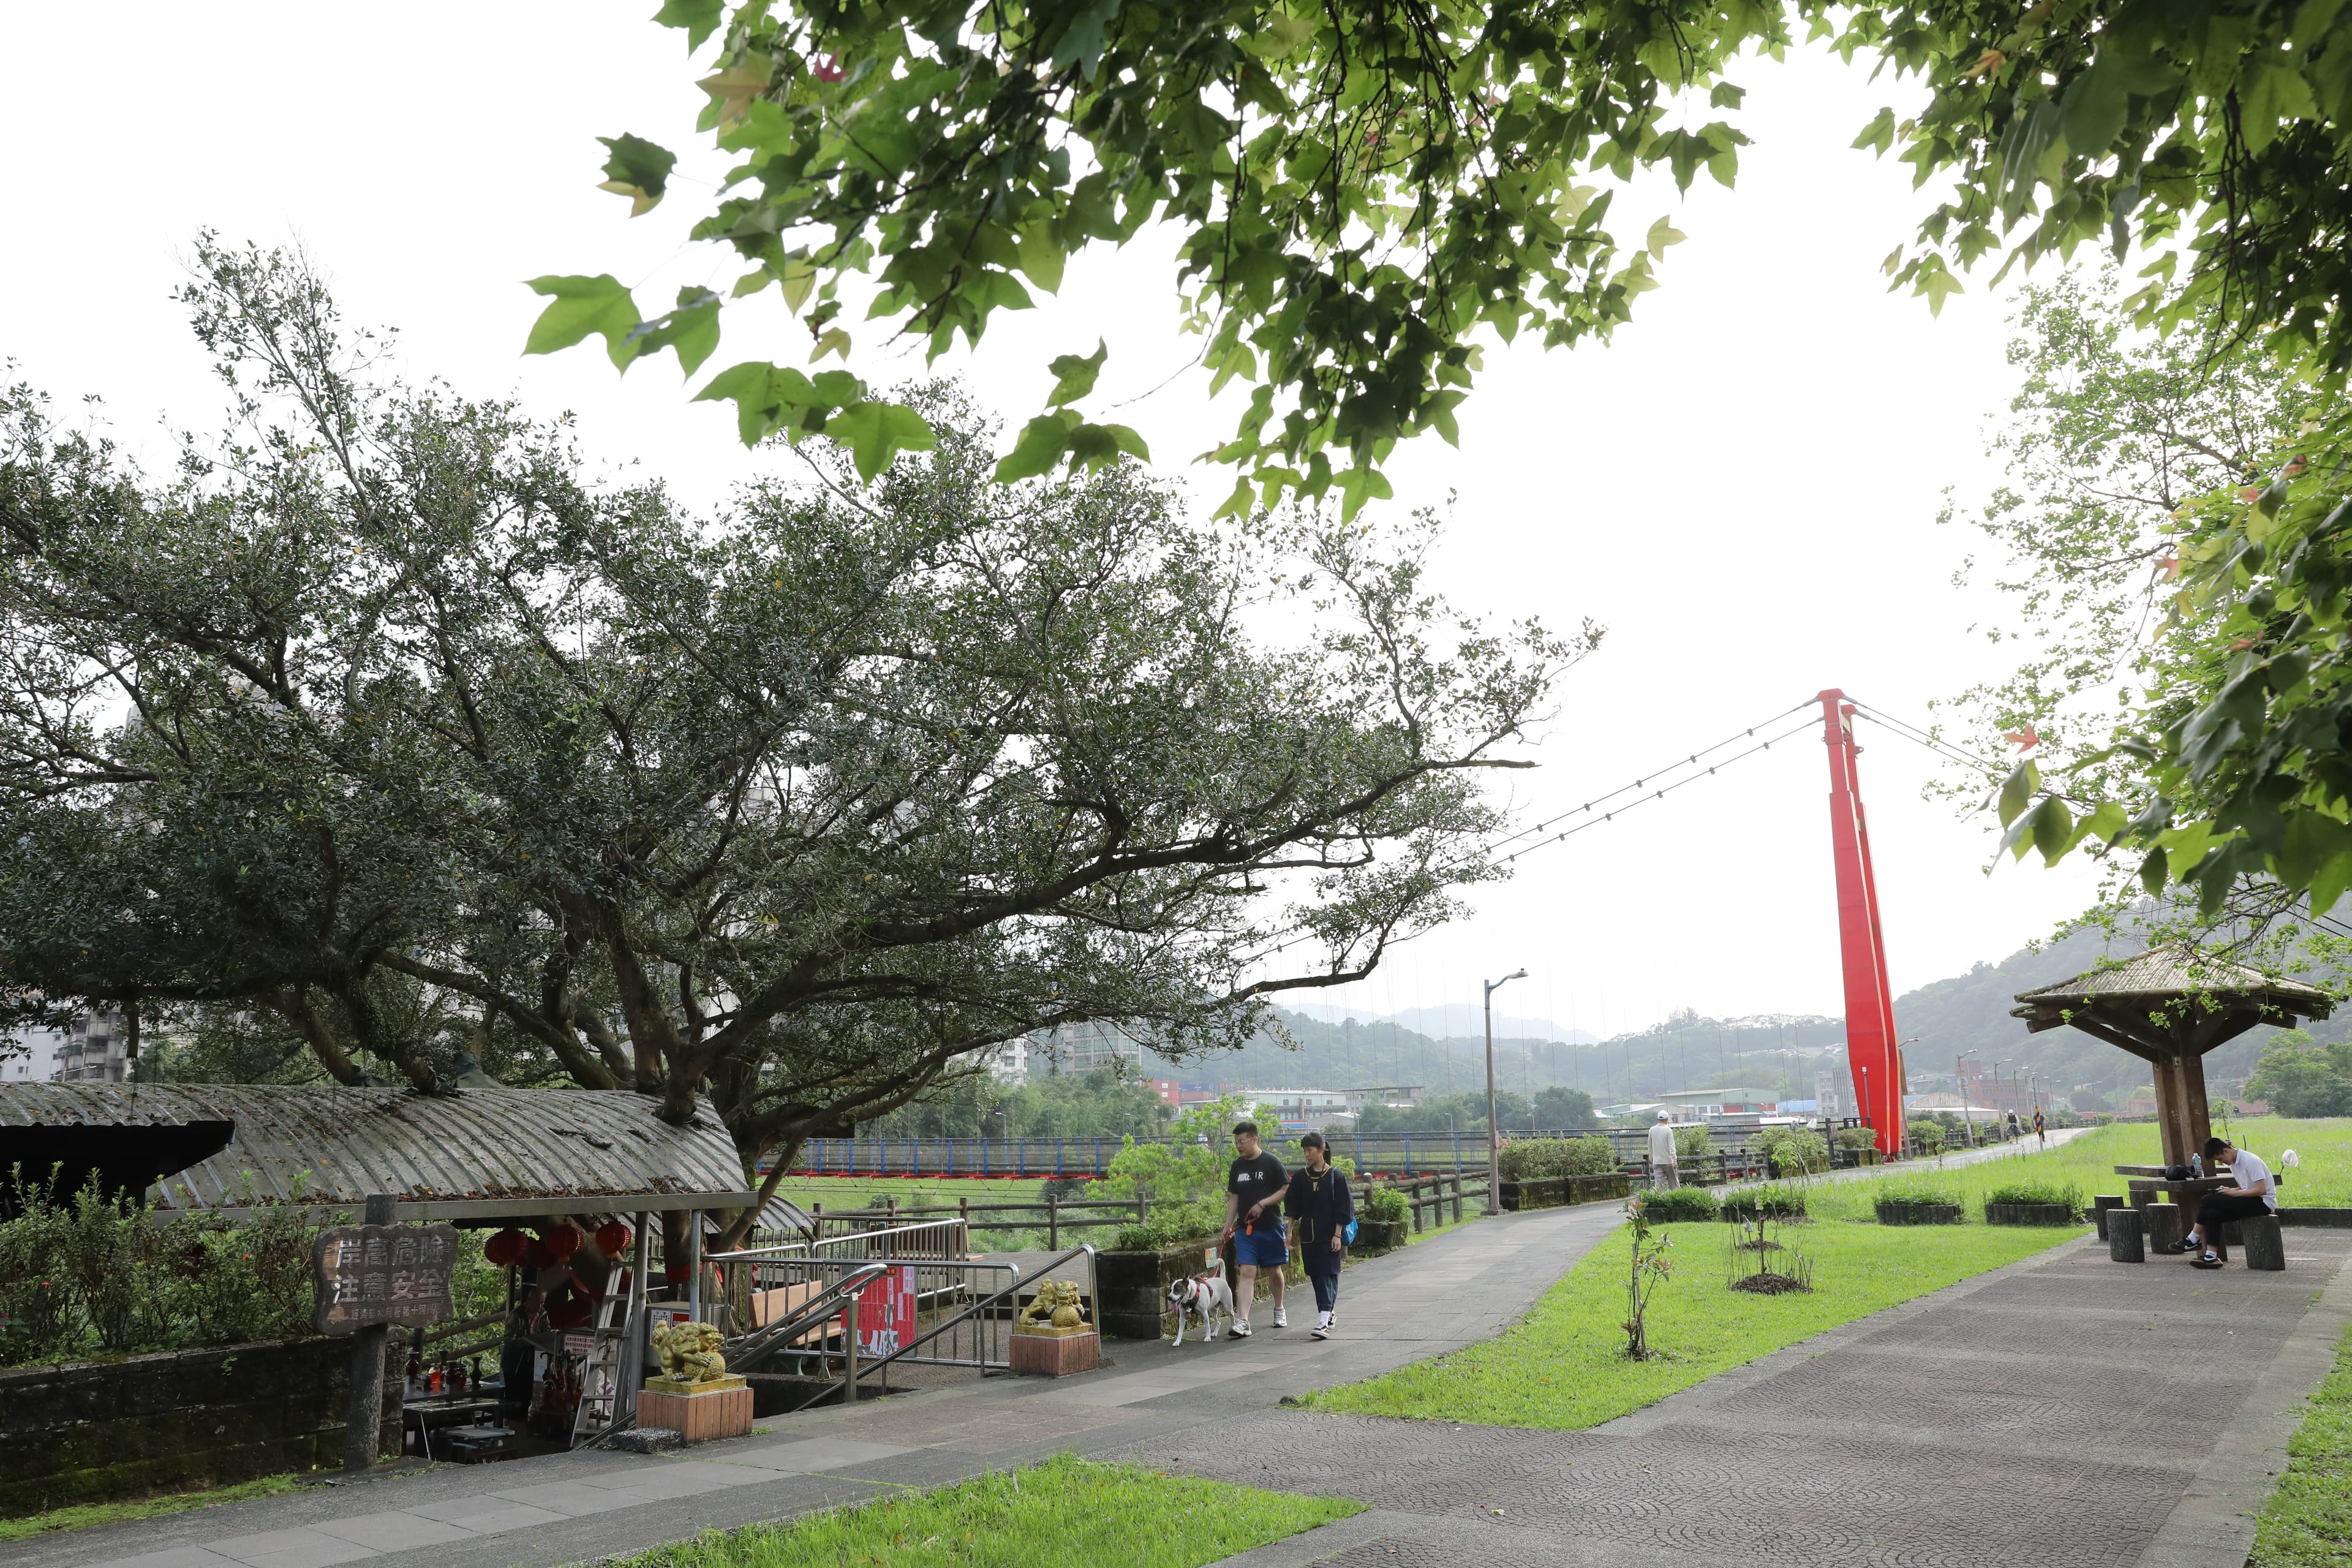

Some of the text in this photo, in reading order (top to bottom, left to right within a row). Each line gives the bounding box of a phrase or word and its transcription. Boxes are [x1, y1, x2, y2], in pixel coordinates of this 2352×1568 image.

[336, 1235, 444, 1268] 岸高危險
[331, 1268, 443, 1304] 注意安全
